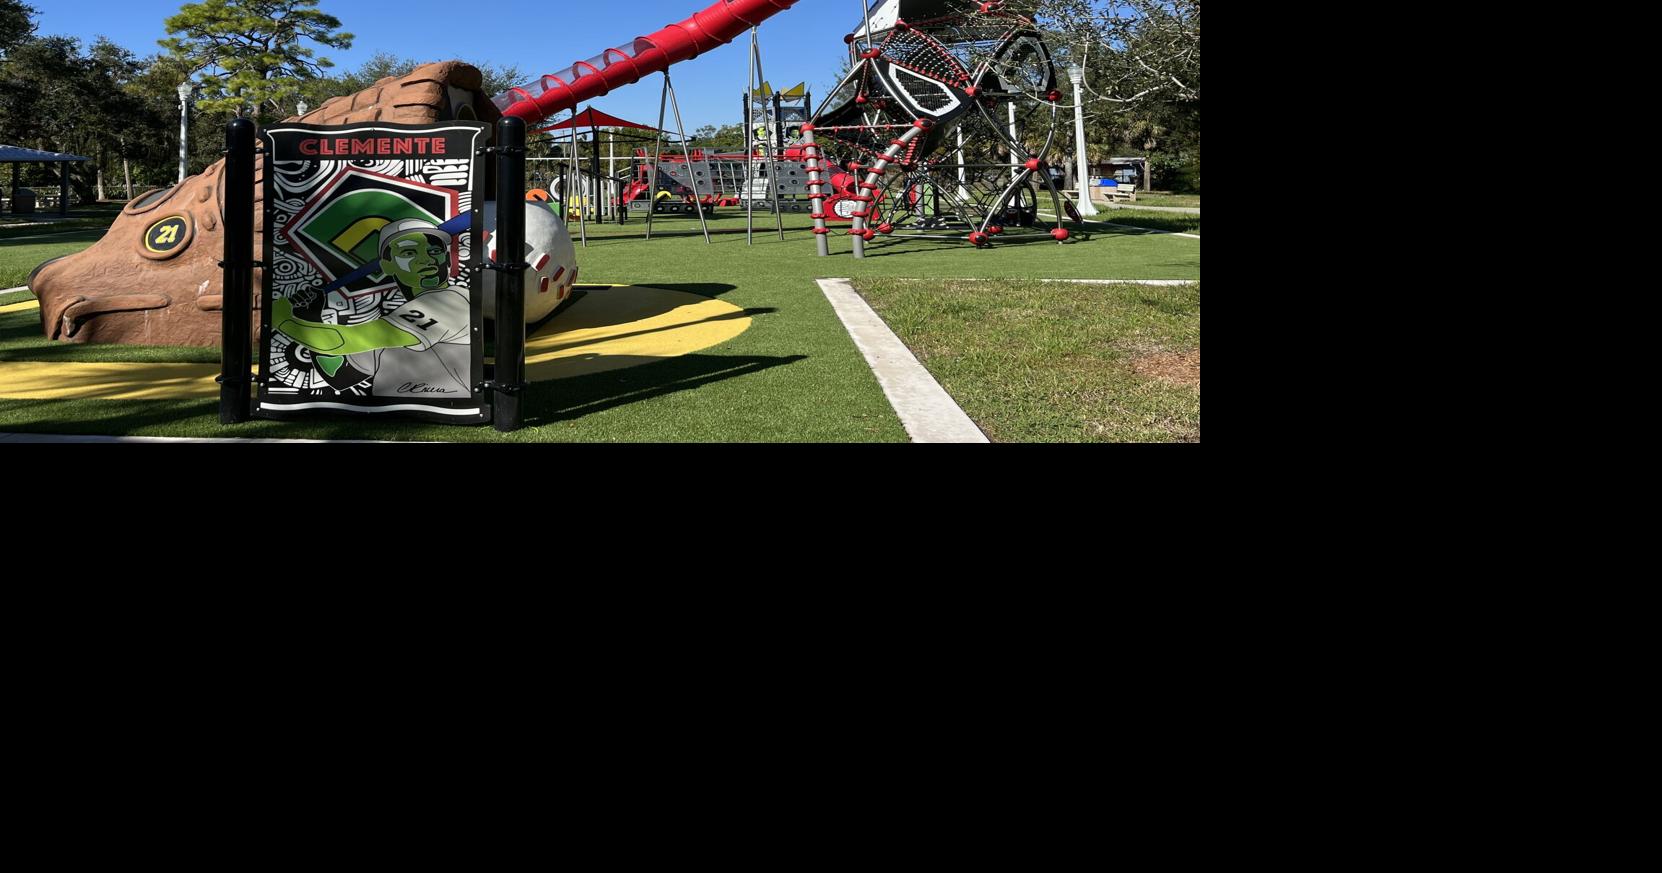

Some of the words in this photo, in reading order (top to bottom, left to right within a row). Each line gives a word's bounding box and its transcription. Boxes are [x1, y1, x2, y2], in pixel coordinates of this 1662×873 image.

[299, 137, 446, 155] CLEMENTE
[155, 225, 179, 244] 21
[399, 310, 438, 331] 21
